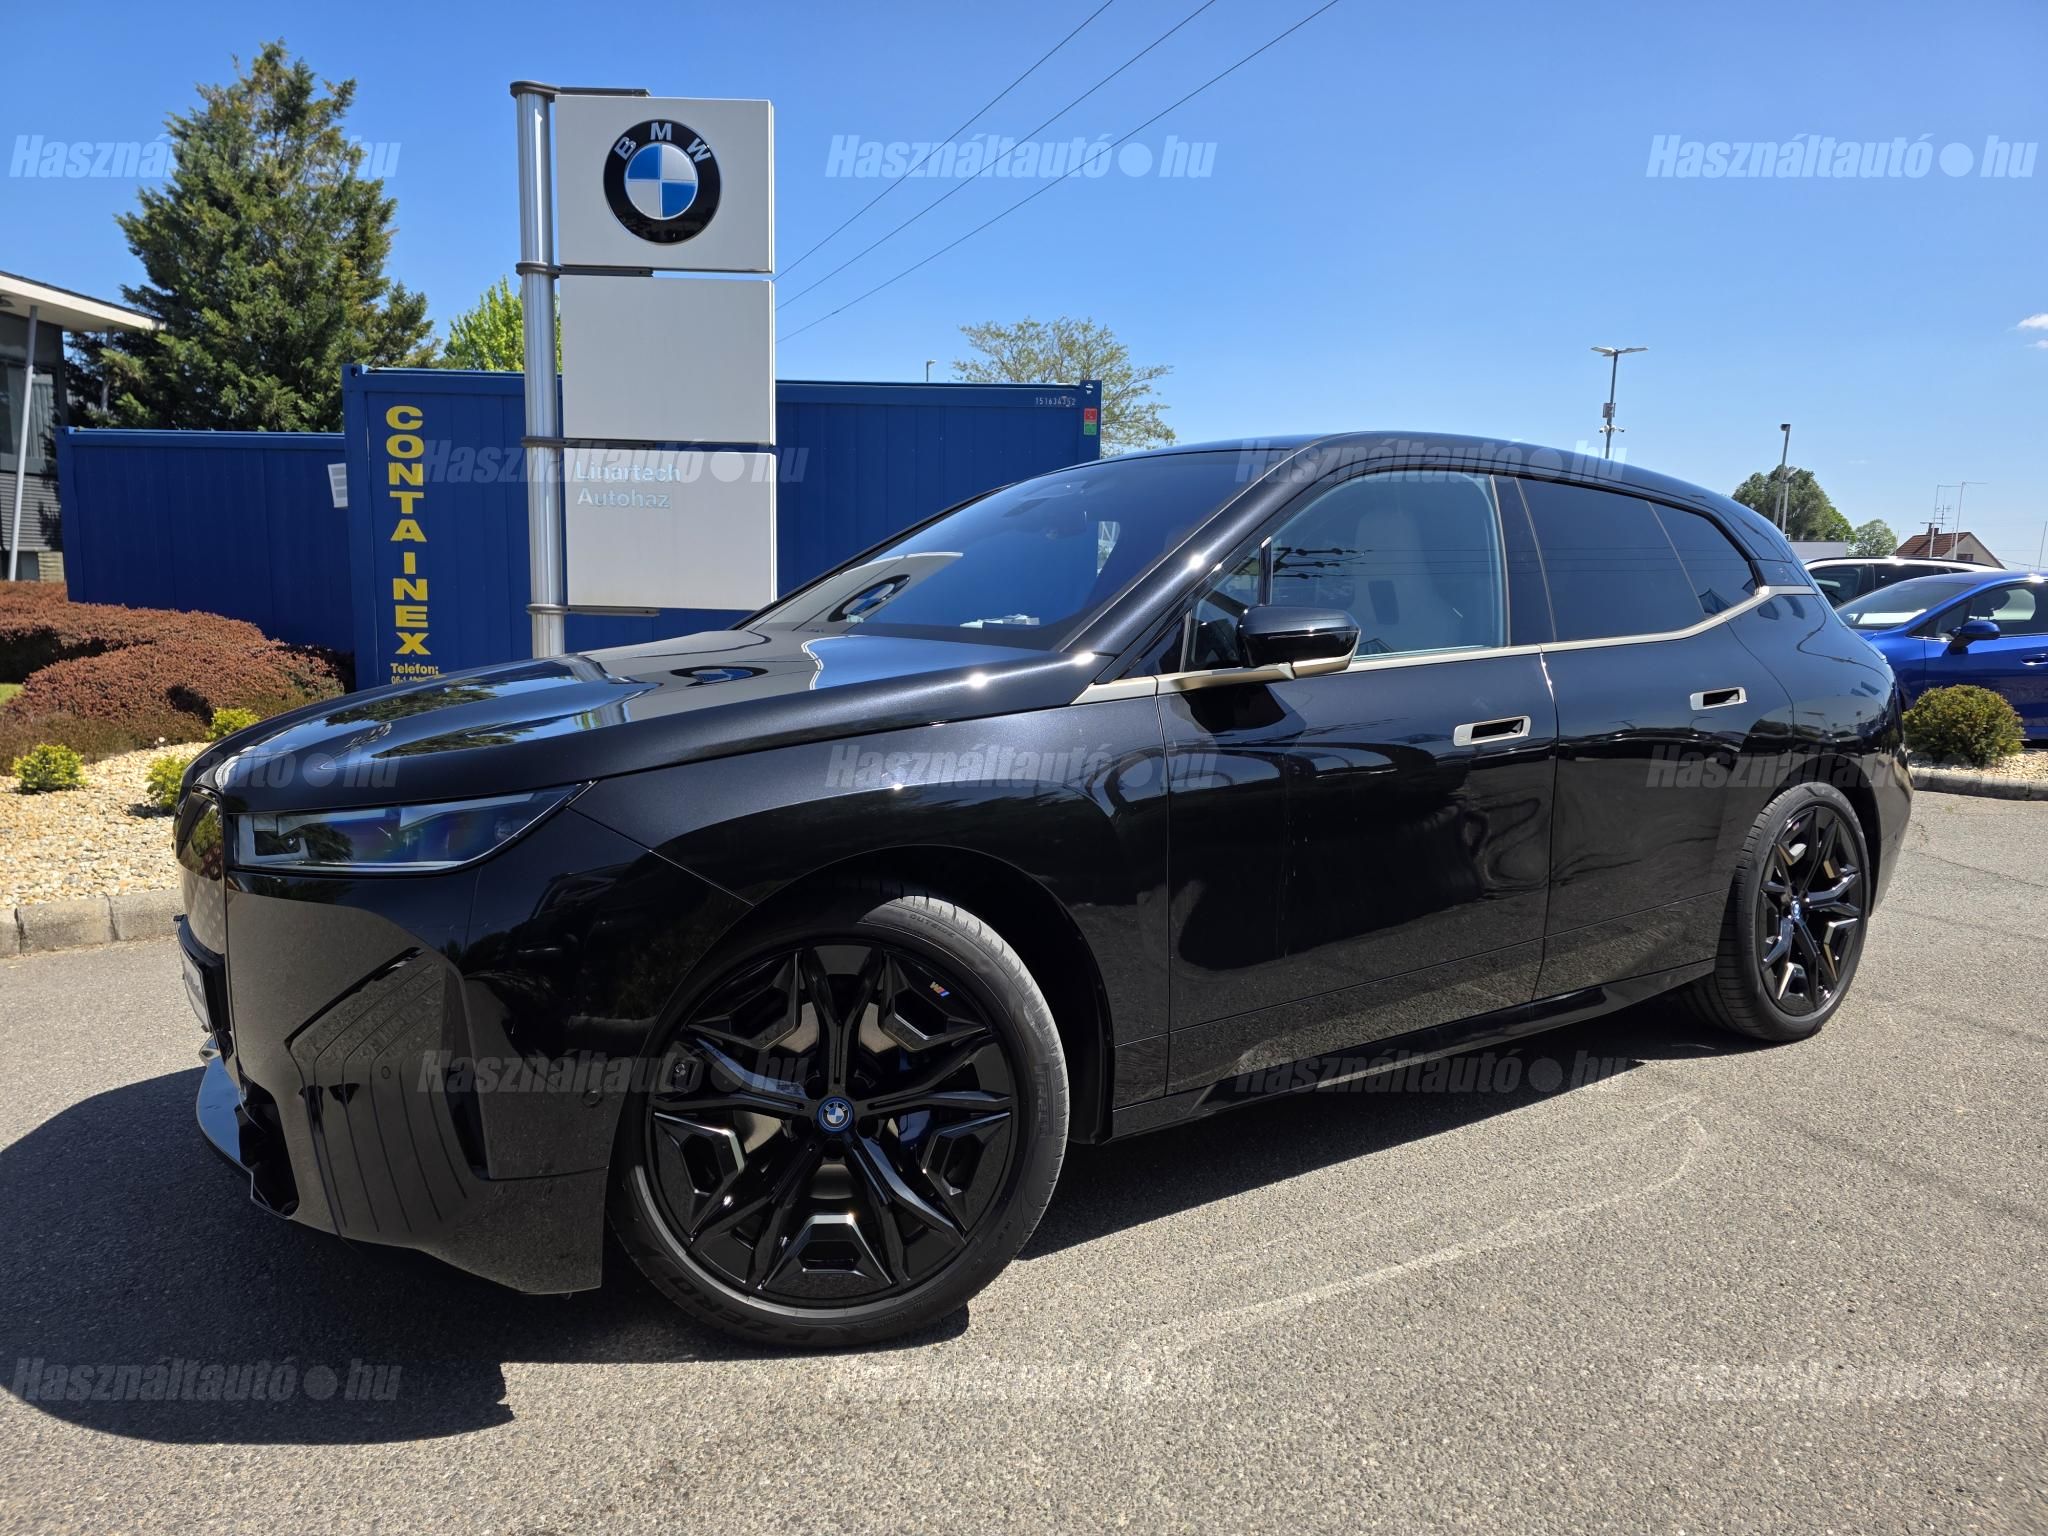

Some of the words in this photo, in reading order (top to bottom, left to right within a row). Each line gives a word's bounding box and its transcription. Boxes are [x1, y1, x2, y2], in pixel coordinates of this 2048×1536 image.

[613, 122, 712, 163] BMW
[575, 461, 681, 481] Linartech
[385, 405, 432, 656] CONTAINEX
